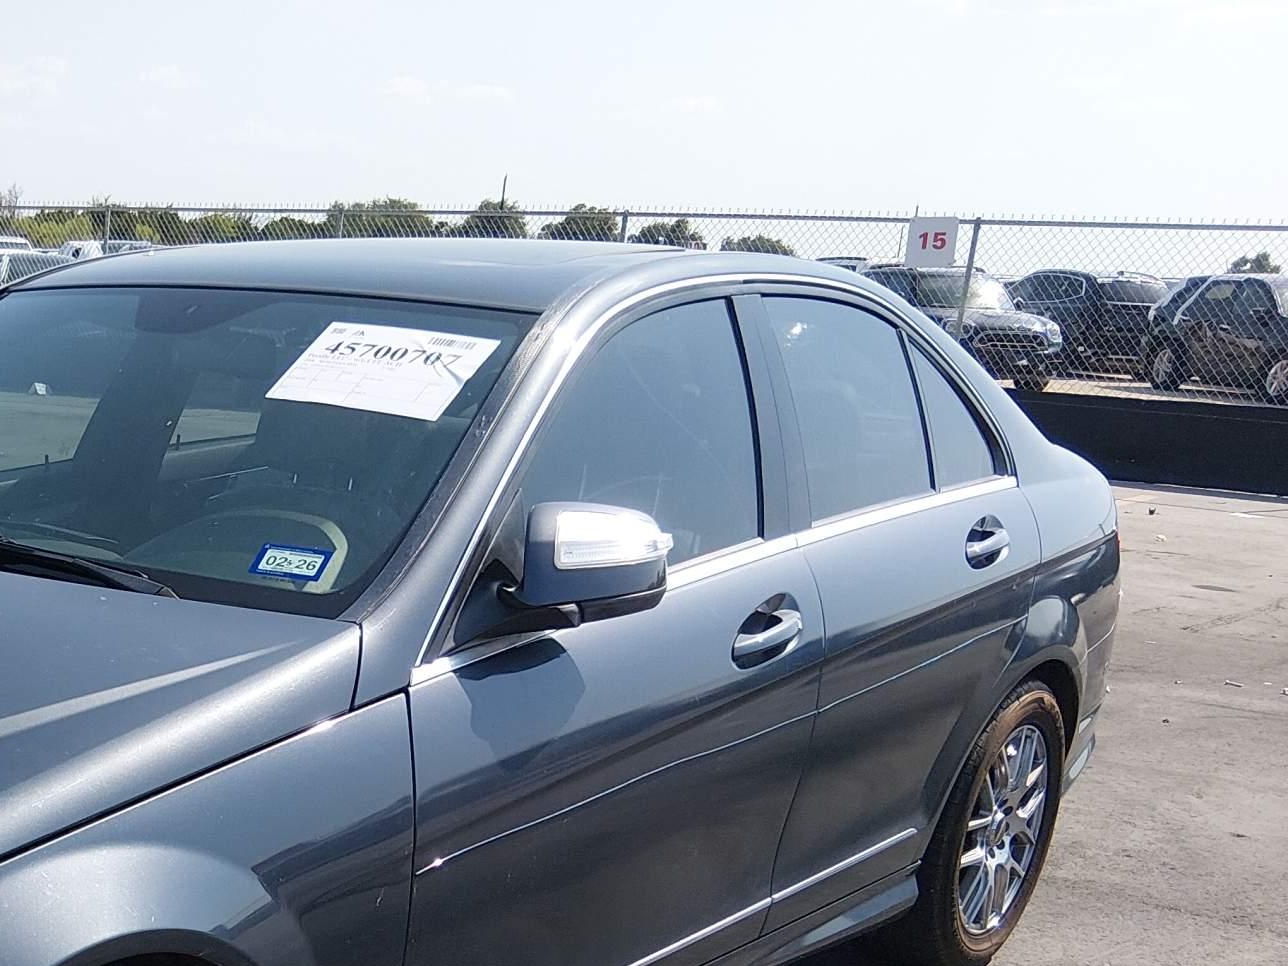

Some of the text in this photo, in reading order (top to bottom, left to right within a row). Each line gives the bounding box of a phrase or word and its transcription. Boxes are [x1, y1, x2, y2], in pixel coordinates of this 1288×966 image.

[918, 232, 947, 250] 15
[324, 340, 463, 366] 45700707
[265, 555, 318, 571] 02 26
